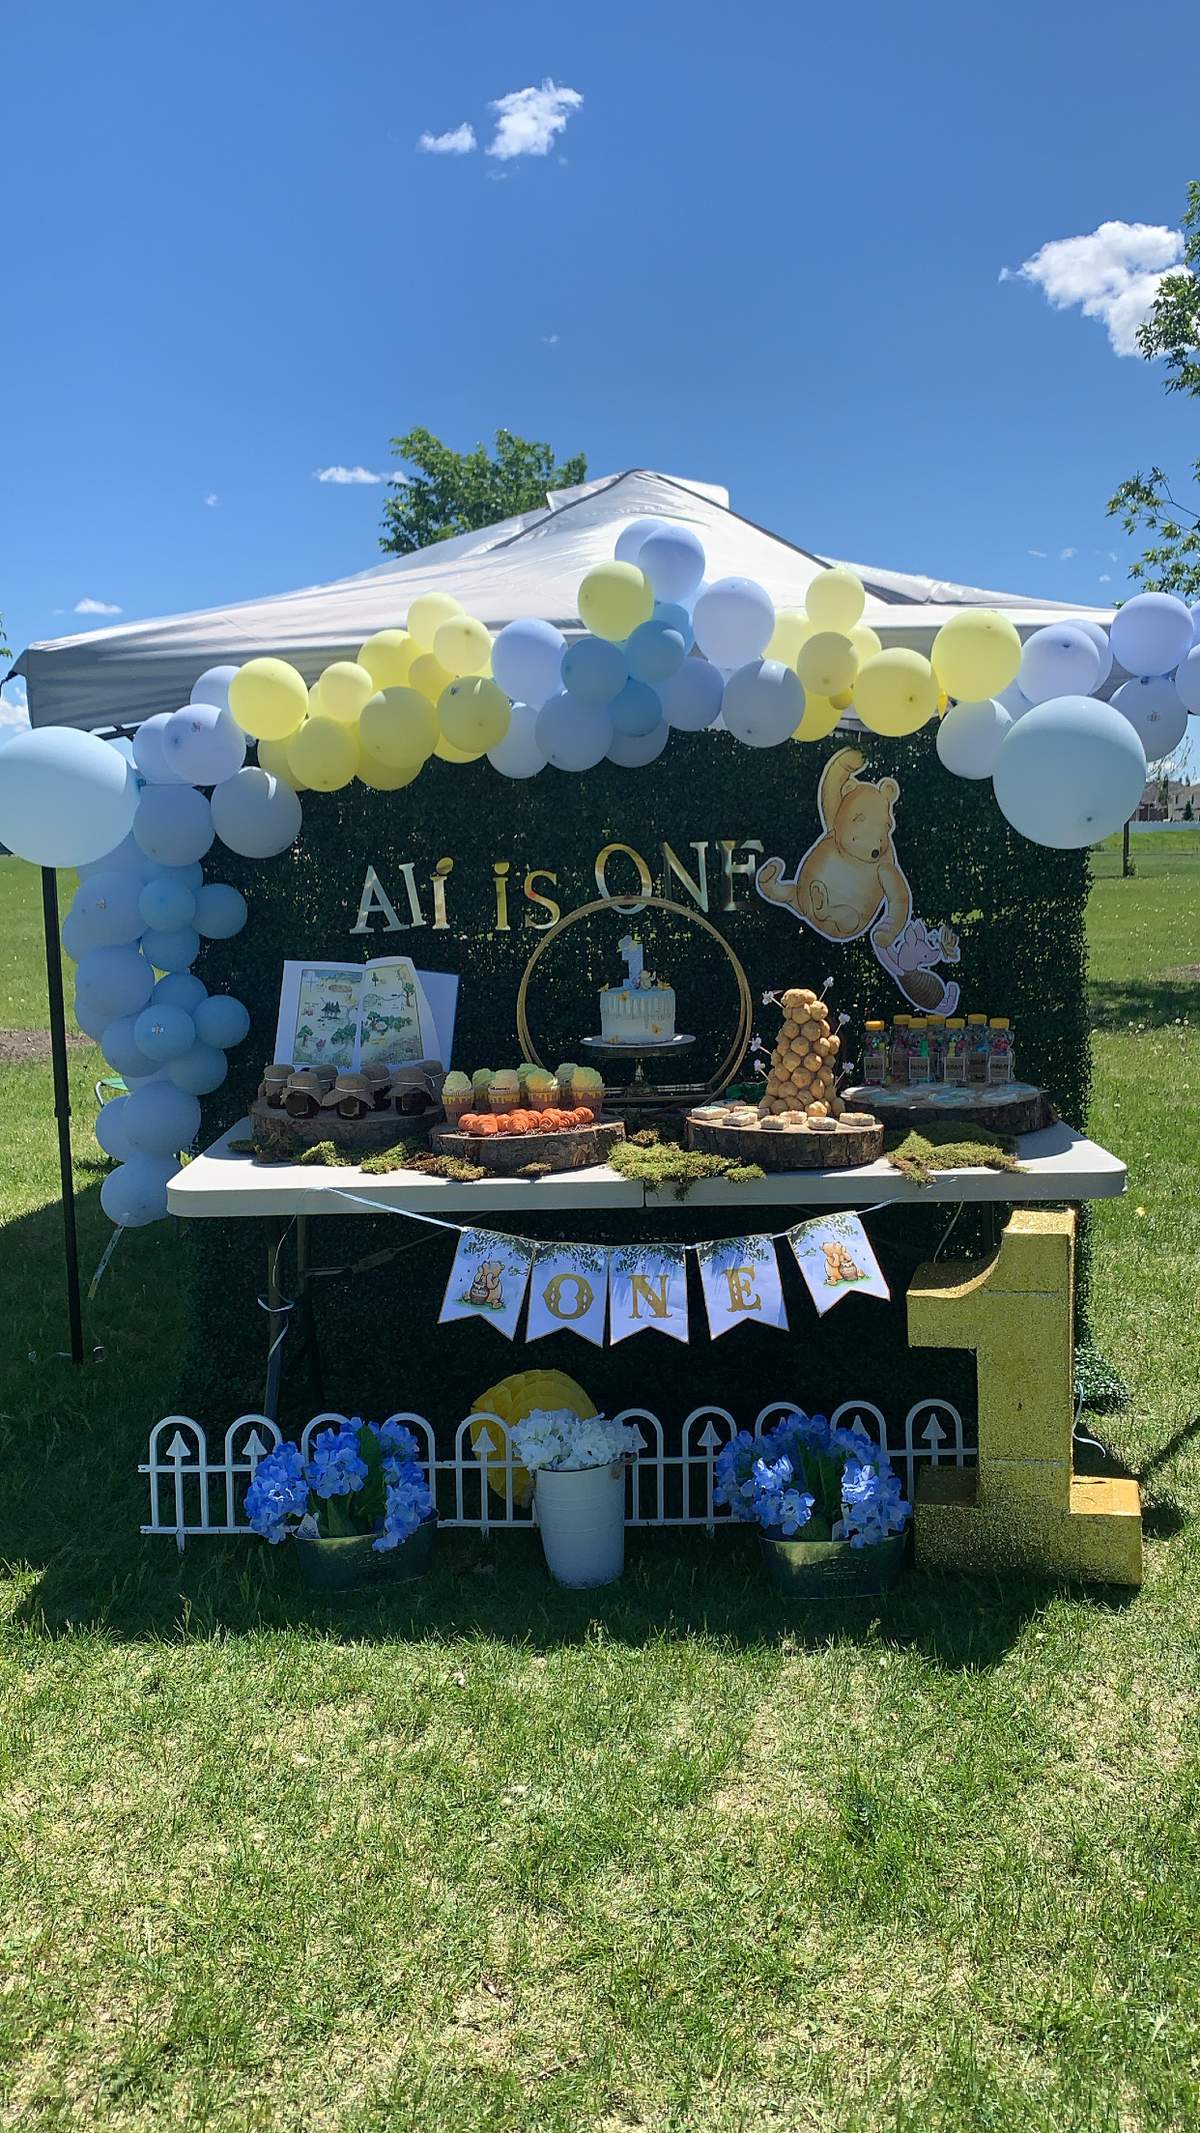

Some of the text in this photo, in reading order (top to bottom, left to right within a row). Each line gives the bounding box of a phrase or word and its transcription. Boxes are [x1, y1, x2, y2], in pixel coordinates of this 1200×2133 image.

[349, 839, 765, 934] Ali is ONE
[621, 941, 644, 989] 1
[541, 1263, 763, 1320] ONE
[907, 1208, 1143, 1586] 1
